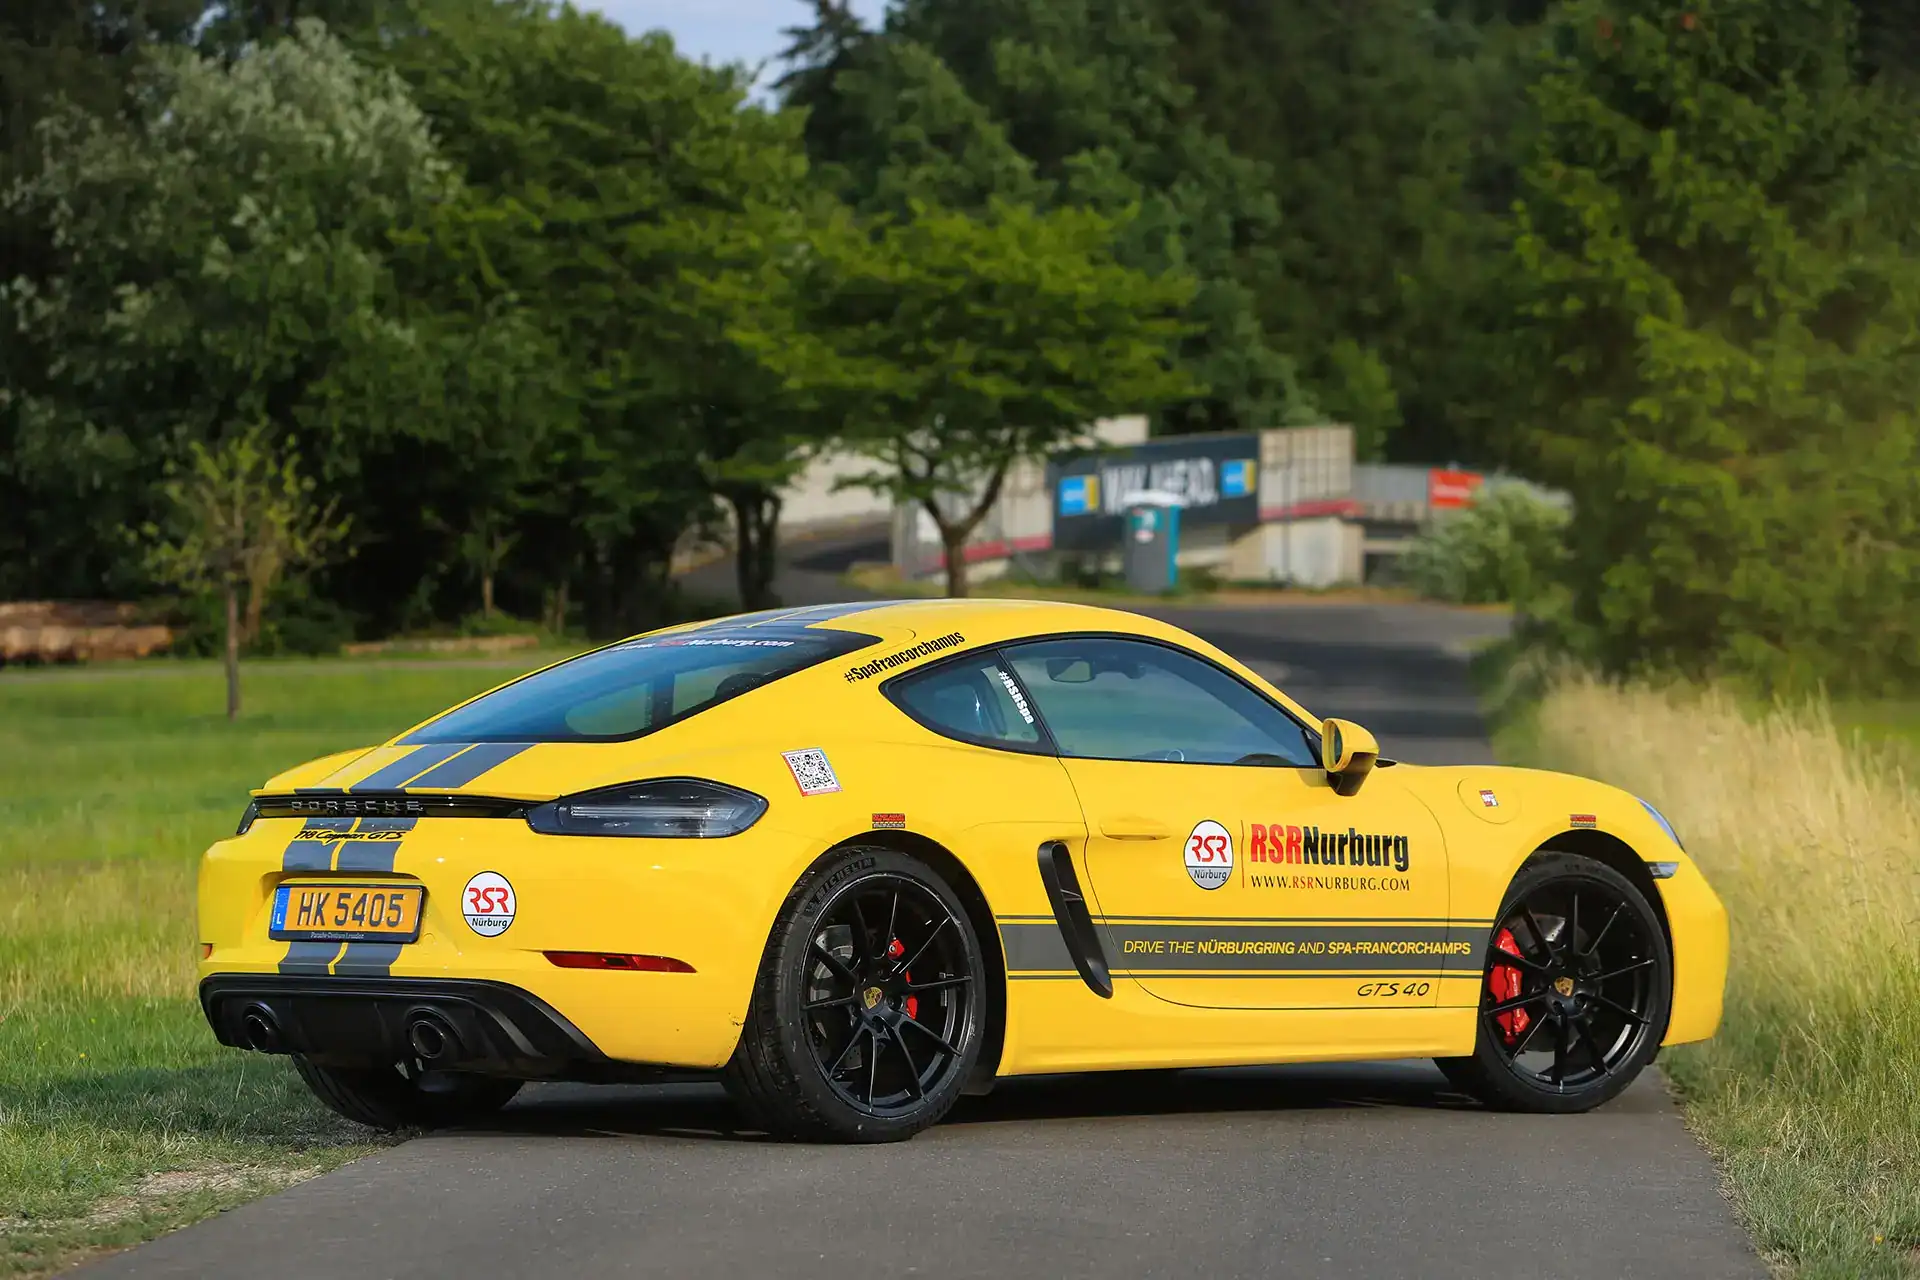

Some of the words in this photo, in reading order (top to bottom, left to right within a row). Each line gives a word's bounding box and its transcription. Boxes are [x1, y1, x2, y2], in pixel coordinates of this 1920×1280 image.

[844, 632, 965, 683] #SpaFrancorchamps
[998, 671, 1034, 725] #RSRSpa
[291, 800, 424, 811] PORSCHE
[294, 831, 317, 839] 718
[315, 831, 367, 843] Cayman
[367, 831, 406, 839] GTS
[1191, 835, 1228, 863] RSR
[1250, 823, 1409, 872] RSRNurburg
[811, 857, 876, 905] MICHELIN
[1193, 868, 1228, 882] Nürburg
[1250, 874, 1410, 892] WWW.RSRNURBURG.COM
[468, 887, 510, 914] RSR
[275, 912, 282, 925] L
[297, 892, 331, 927] HK
[334, 892, 405, 928] 5405
[471, 917, 508, 930] Nürburg
[1124, 940, 1165, 955] DRIVE
[1168, 940, 1196, 955] THE
[1197, 938, 1296, 955] NÜRBURGRING
[1297, 941, 1326, 955] AND
[1327, 941, 1472, 955] SPA-FRANCORCHAMPS
[1357, 982, 1401, 997] GTS
[1402, 982, 1430, 997] 4.0
